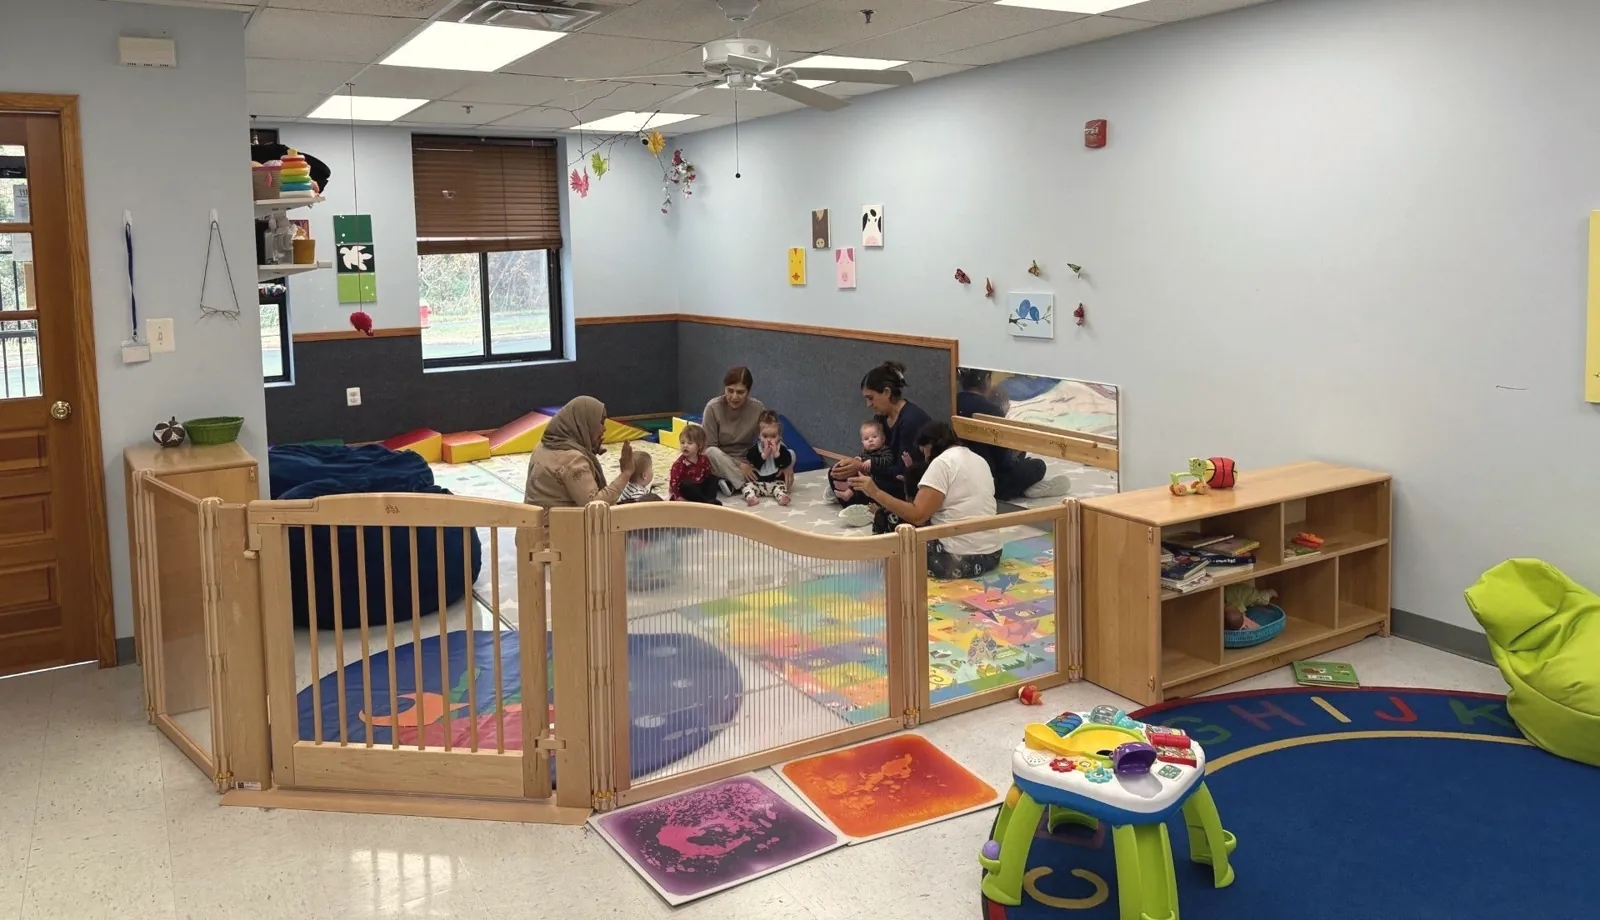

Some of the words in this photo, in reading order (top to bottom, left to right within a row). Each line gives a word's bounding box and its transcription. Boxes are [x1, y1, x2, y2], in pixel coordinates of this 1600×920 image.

[1228, 700, 1306, 731] H
[1310, 696, 1352, 723] I
[1374, 696, 1418, 723] J
[1448, 698, 1517, 730] K
[1023, 866, 1109, 909] C
